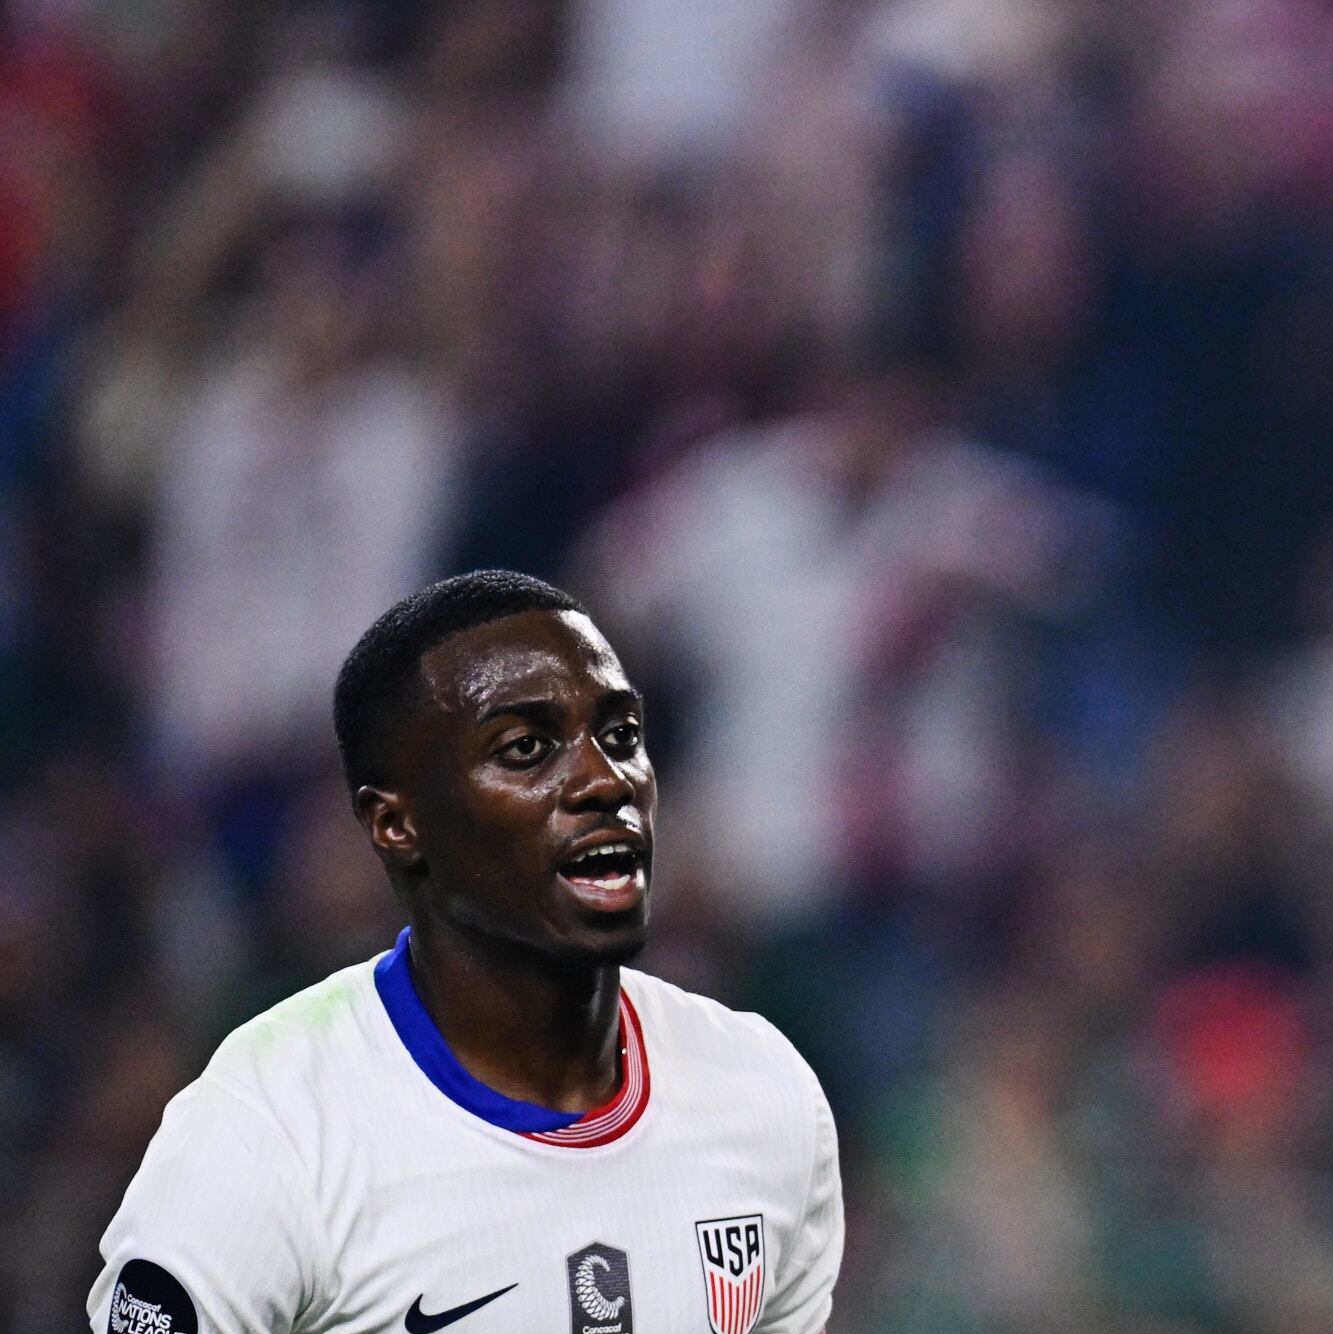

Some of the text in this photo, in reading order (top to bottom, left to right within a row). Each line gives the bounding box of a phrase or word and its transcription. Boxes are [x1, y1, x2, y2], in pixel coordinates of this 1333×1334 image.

[702, 1223, 760, 1277] USA
[119, 1298, 173, 1330] NATIONS
[127, 1293, 162, 1313] Concacaf
